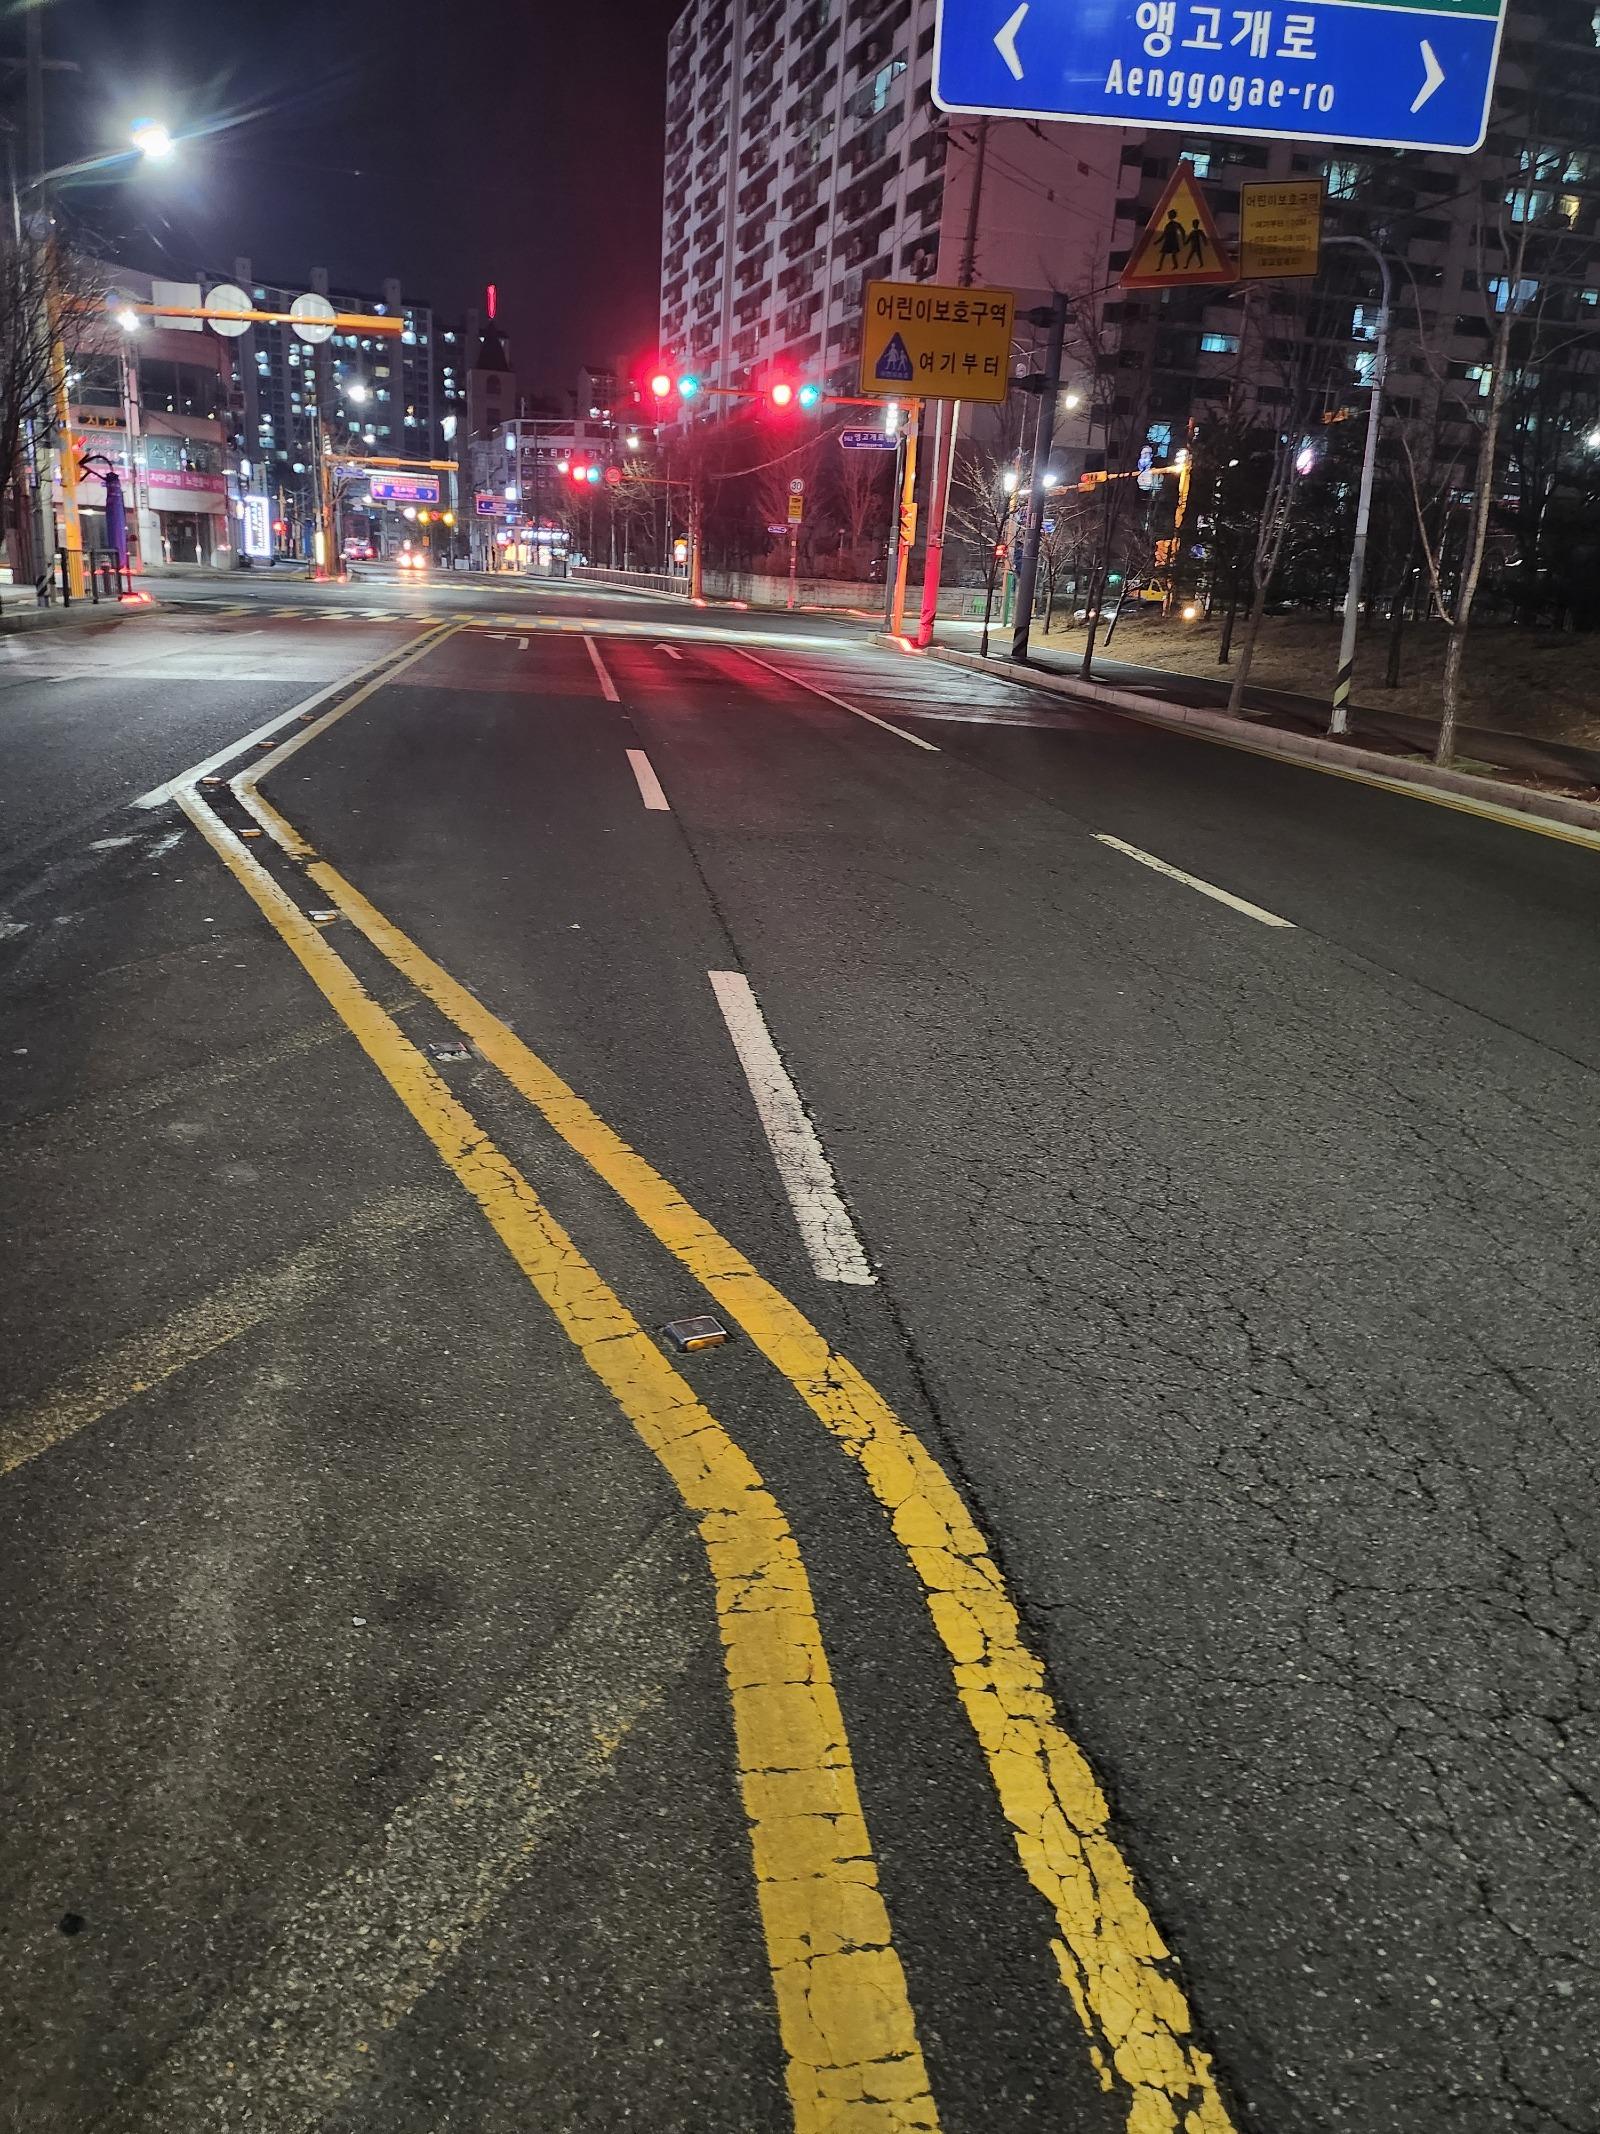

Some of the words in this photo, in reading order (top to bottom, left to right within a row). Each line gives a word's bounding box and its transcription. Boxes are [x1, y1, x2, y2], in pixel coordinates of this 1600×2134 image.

[1135, 1, 1317, 60] 앵고개로
[1104, 59, 1335, 112] Aenggogae-ro
[876, 295, 1008, 328] 어린이보호구역
[791, 481, 802, 490] 30
